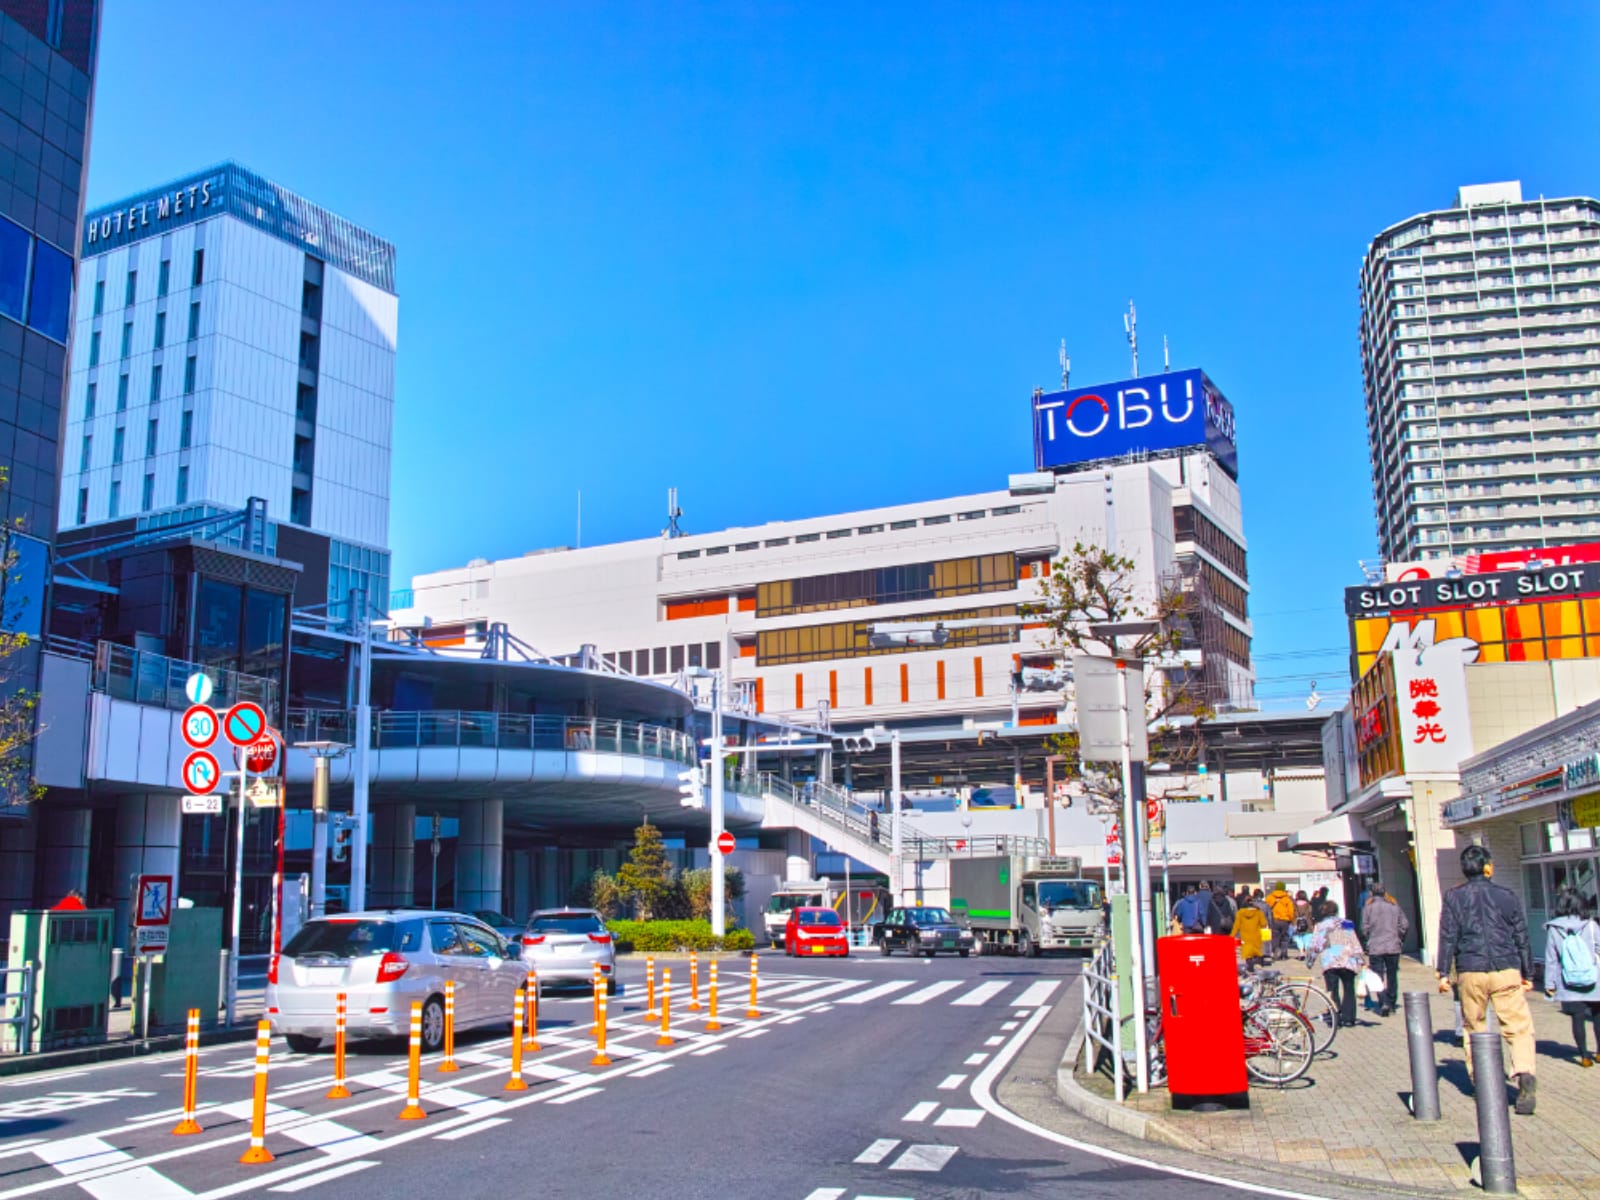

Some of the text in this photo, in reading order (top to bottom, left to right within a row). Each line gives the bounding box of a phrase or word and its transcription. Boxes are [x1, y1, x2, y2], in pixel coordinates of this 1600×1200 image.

[88, 181, 211, 243] HOTEL METS
[1035, 379, 1194, 441] TOBU
[1360, 570, 1585, 609] SLOT SLOT SLOT
[190, 717, 211, 736] 30
